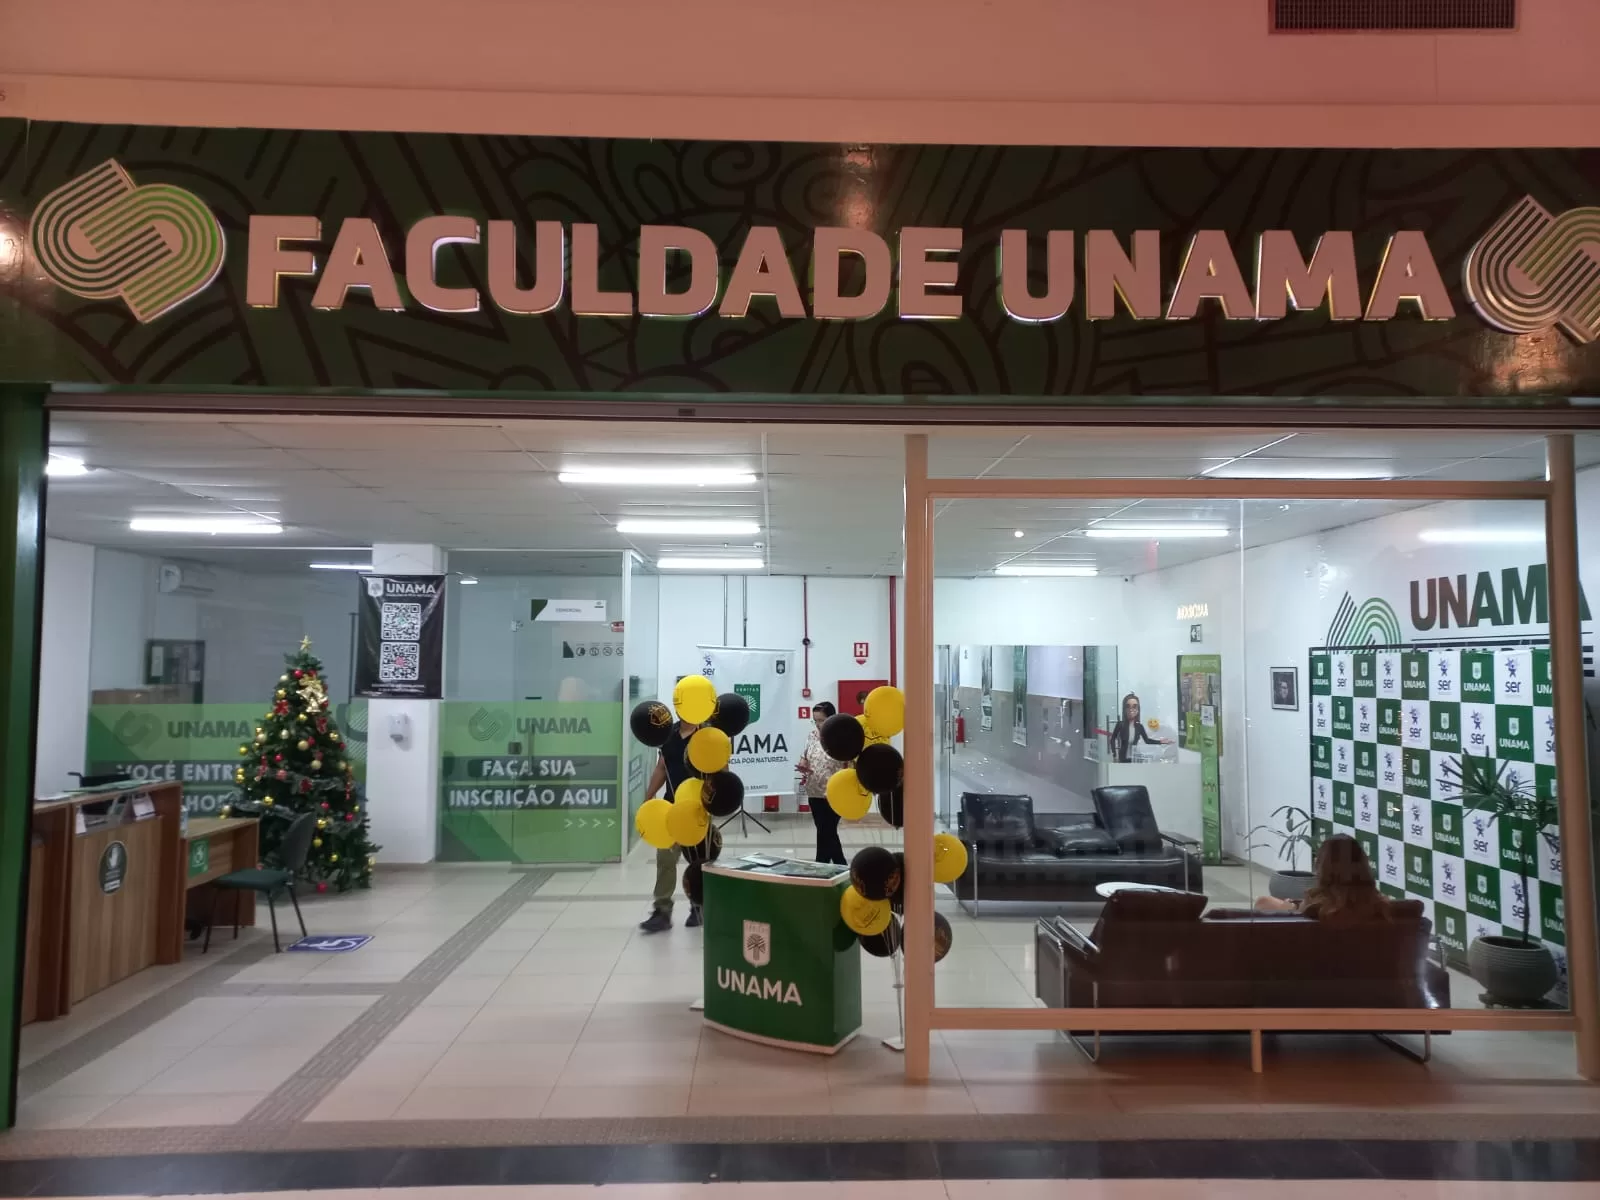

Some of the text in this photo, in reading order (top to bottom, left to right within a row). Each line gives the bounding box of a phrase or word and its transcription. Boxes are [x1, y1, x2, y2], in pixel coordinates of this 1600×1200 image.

[246, 214, 1456, 322] FACULDADE UNAMA
[386, 583, 436, 594] UNAMA
[855, 643, 867, 656] H
[702, 668, 715, 676] ser
[1337, 678, 1347, 687] ser
[1383, 679, 1394, 688] ser
[1403, 680, 1426, 689] UNAMA
[1438, 680, 1451, 690] ser
[1463, 682, 1491, 692] UNAMA
[1505, 681, 1521, 693] ser
[1536, 684, 1552, 694] UNA
[167, 720, 251, 739] UNAMA
[516, 717, 592, 735] UNAMA
[1360, 722, 1370, 733] ser
[1378, 727, 1399, 735] UNAMA
[1409, 727, 1422, 738] ser
[1432, 731, 1458, 742] UNAMA
[1470, 733, 1485, 744] ser
[731, 733, 789, 755] AMA
[1499, 738, 1530, 750] UNAMA
[183, 763, 240, 782] ENTR
[482, 759, 577, 778] FAÇA SUA
[1384, 771, 1395, 781] ser
[1405, 776, 1429, 788] UNAMA
[449, 784, 609, 809] INSCRIÇÃO AQUI
[1411, 823, 1424, 836] ser
[1434, 831, 1460, 845] UNAMA
[1473, 839, 1488, 853] ser
[1550, 858, 1562, 873] se
[1441, 882, 1456, 896] ser
[1468, 892, 1498, 910] UNAMA
[1512, 904, 1525, 919] se
[716, 966, 803, 1006] UNAMA
